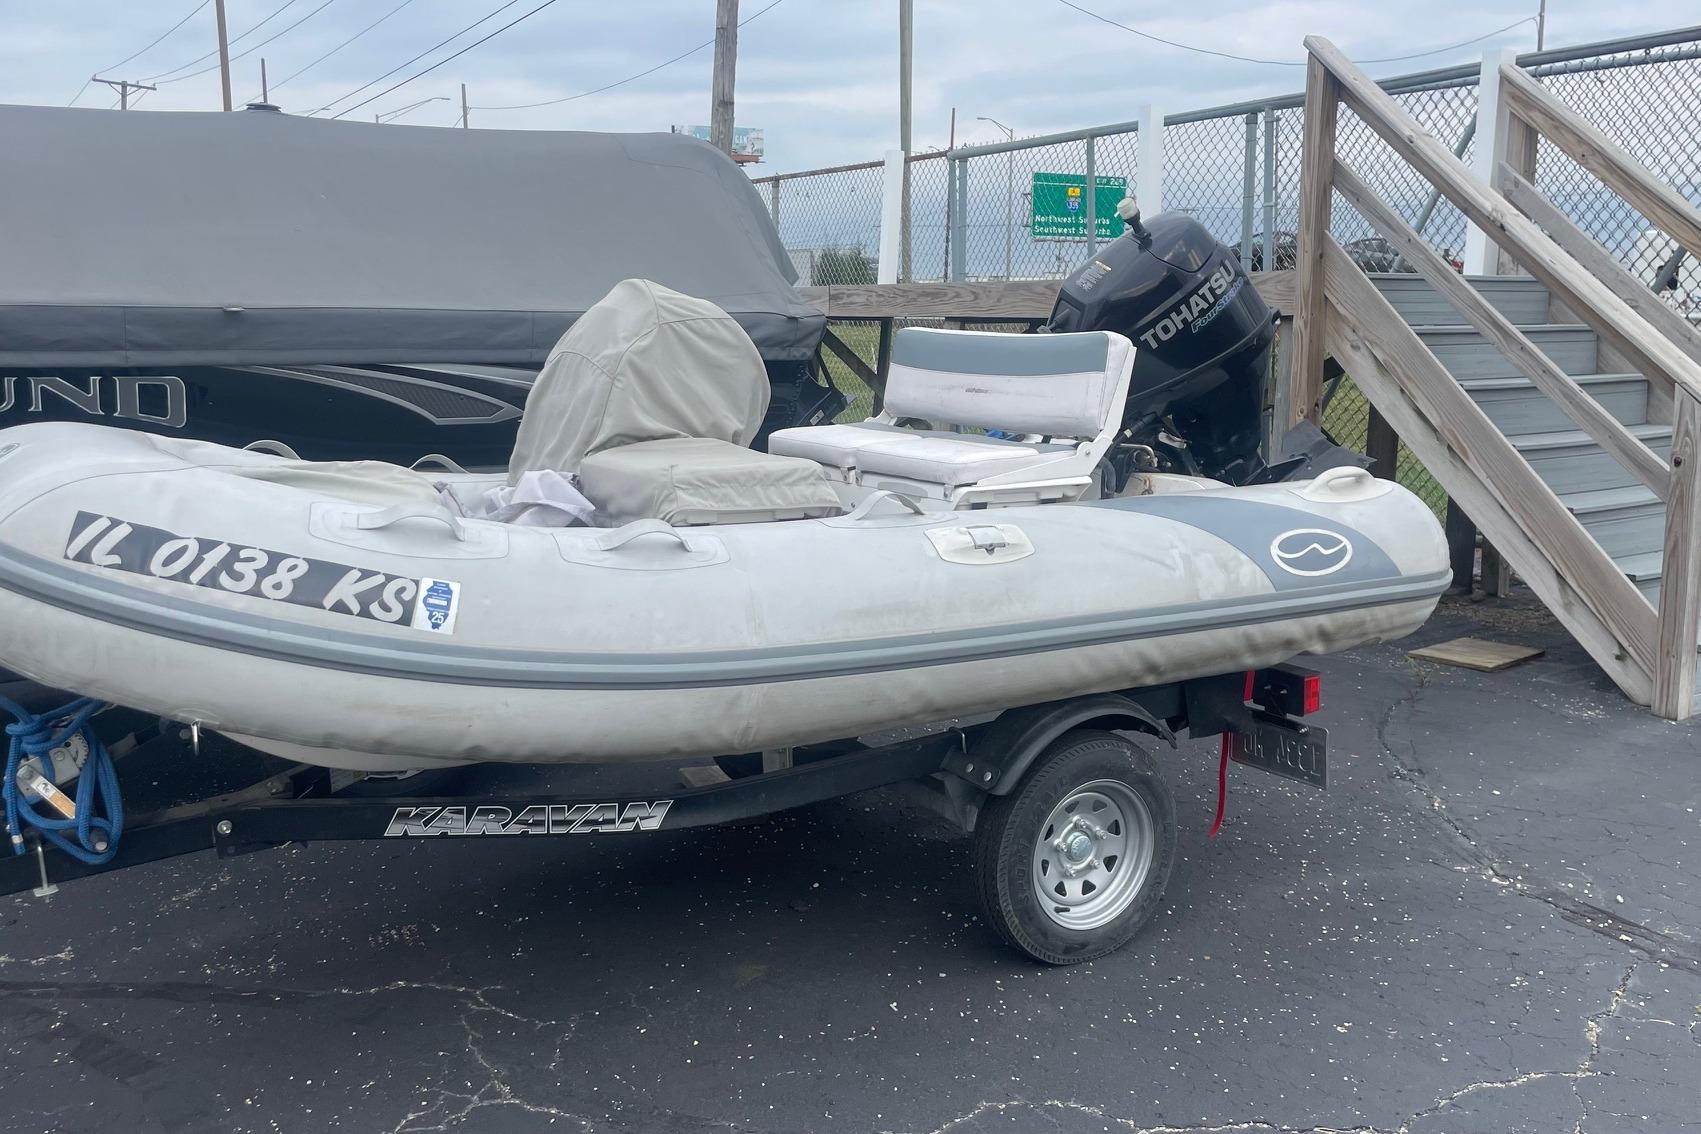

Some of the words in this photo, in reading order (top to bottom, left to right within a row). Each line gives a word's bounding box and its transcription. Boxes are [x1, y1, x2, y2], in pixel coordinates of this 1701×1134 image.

[1034, 225, 1076, 234] Southwest
[1139, 259, 1236, 350] TOHATSU
[66, 516, 133, 567] IL
[149, 537, 309, 600] 0138
[322, 568, 418, 623] KS
[431, 611, 444, 624] 25
[384, 800, 674, 836] KARAVAN
